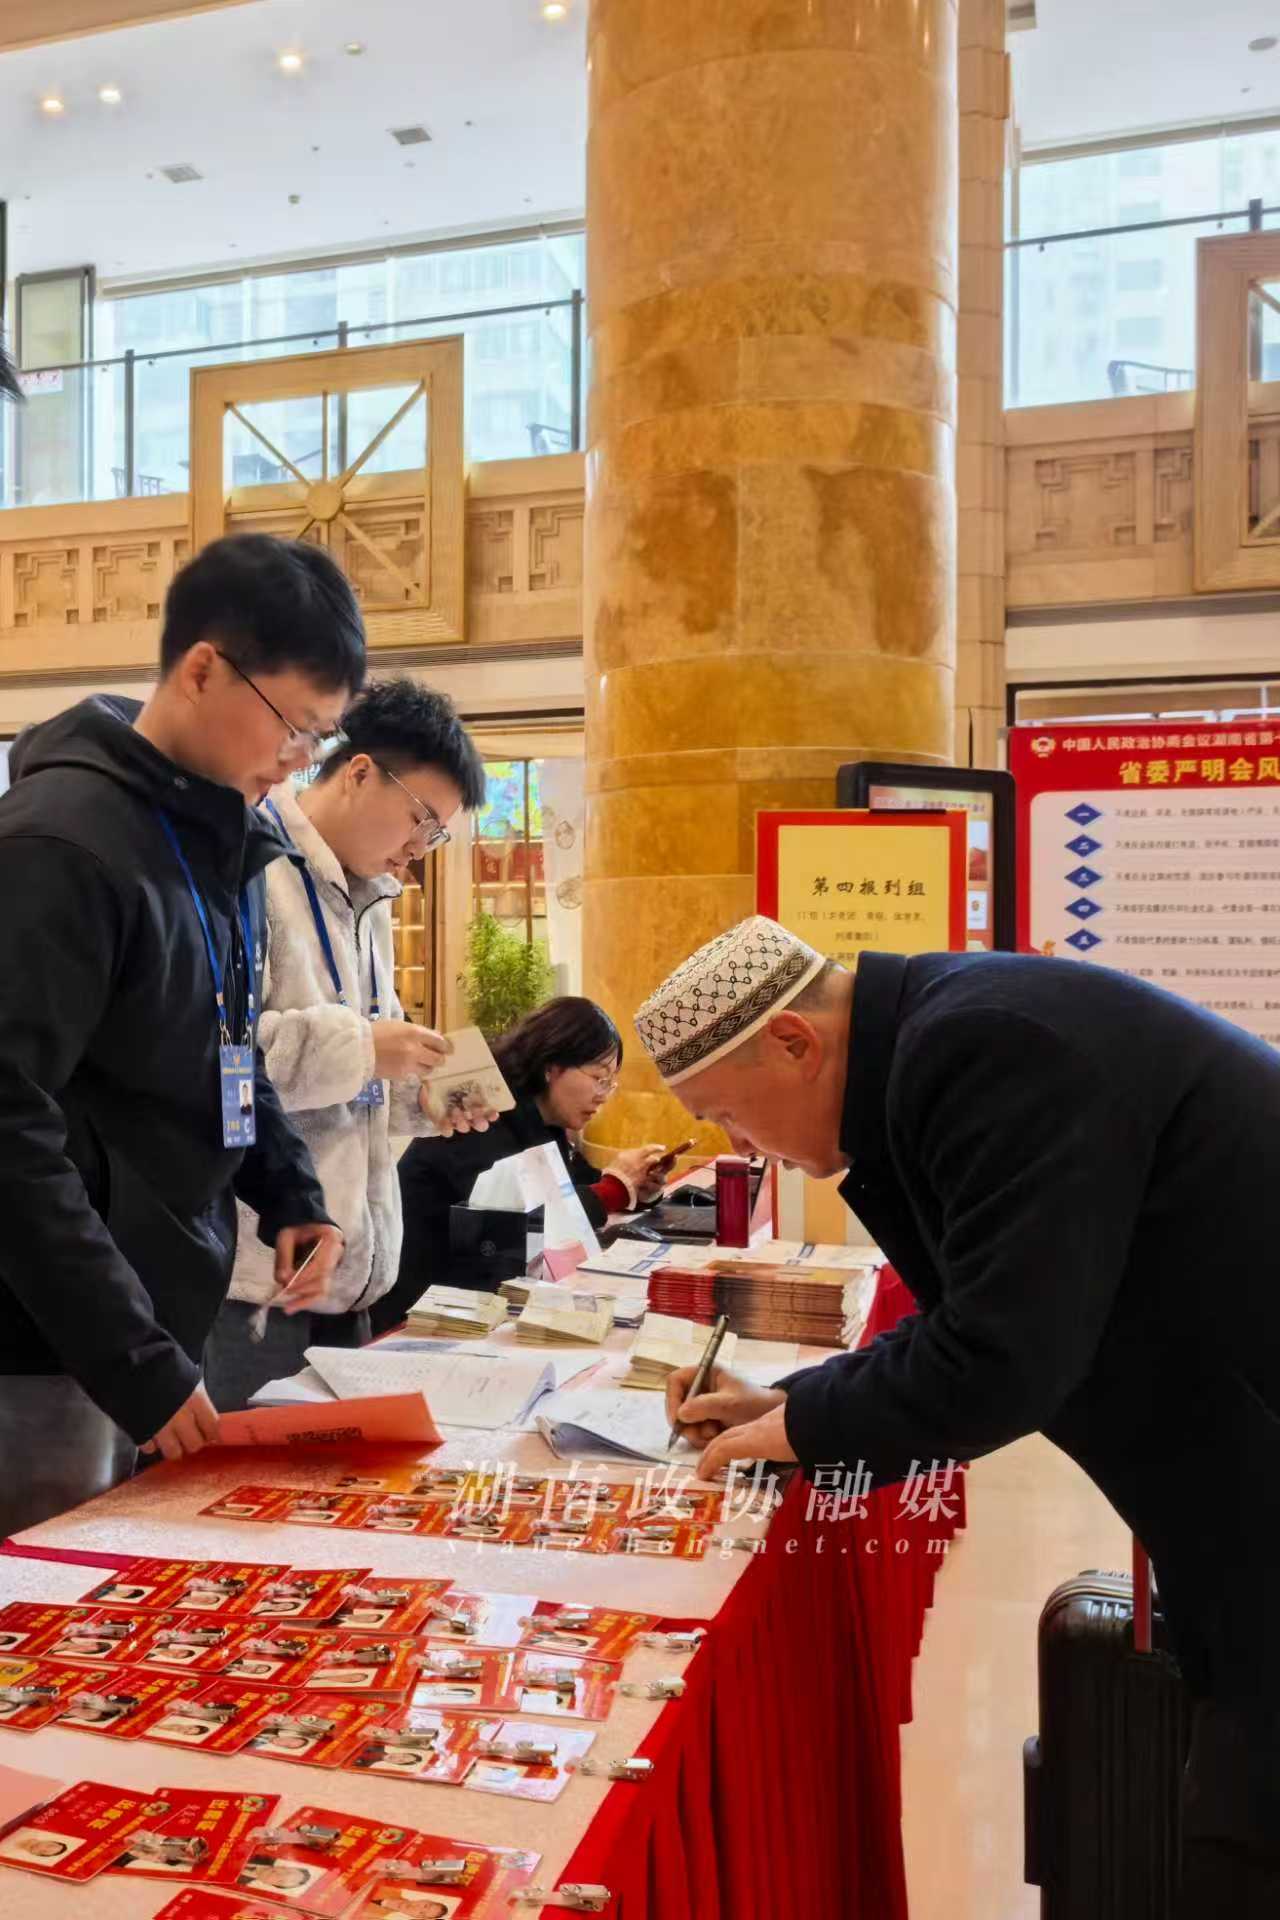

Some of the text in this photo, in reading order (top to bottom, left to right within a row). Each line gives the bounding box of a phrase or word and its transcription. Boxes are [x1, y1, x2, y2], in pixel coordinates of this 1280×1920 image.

[1119, 756, 1280, 784] 省委严明会风
[812, 876, 925, 897] 第四报到组
